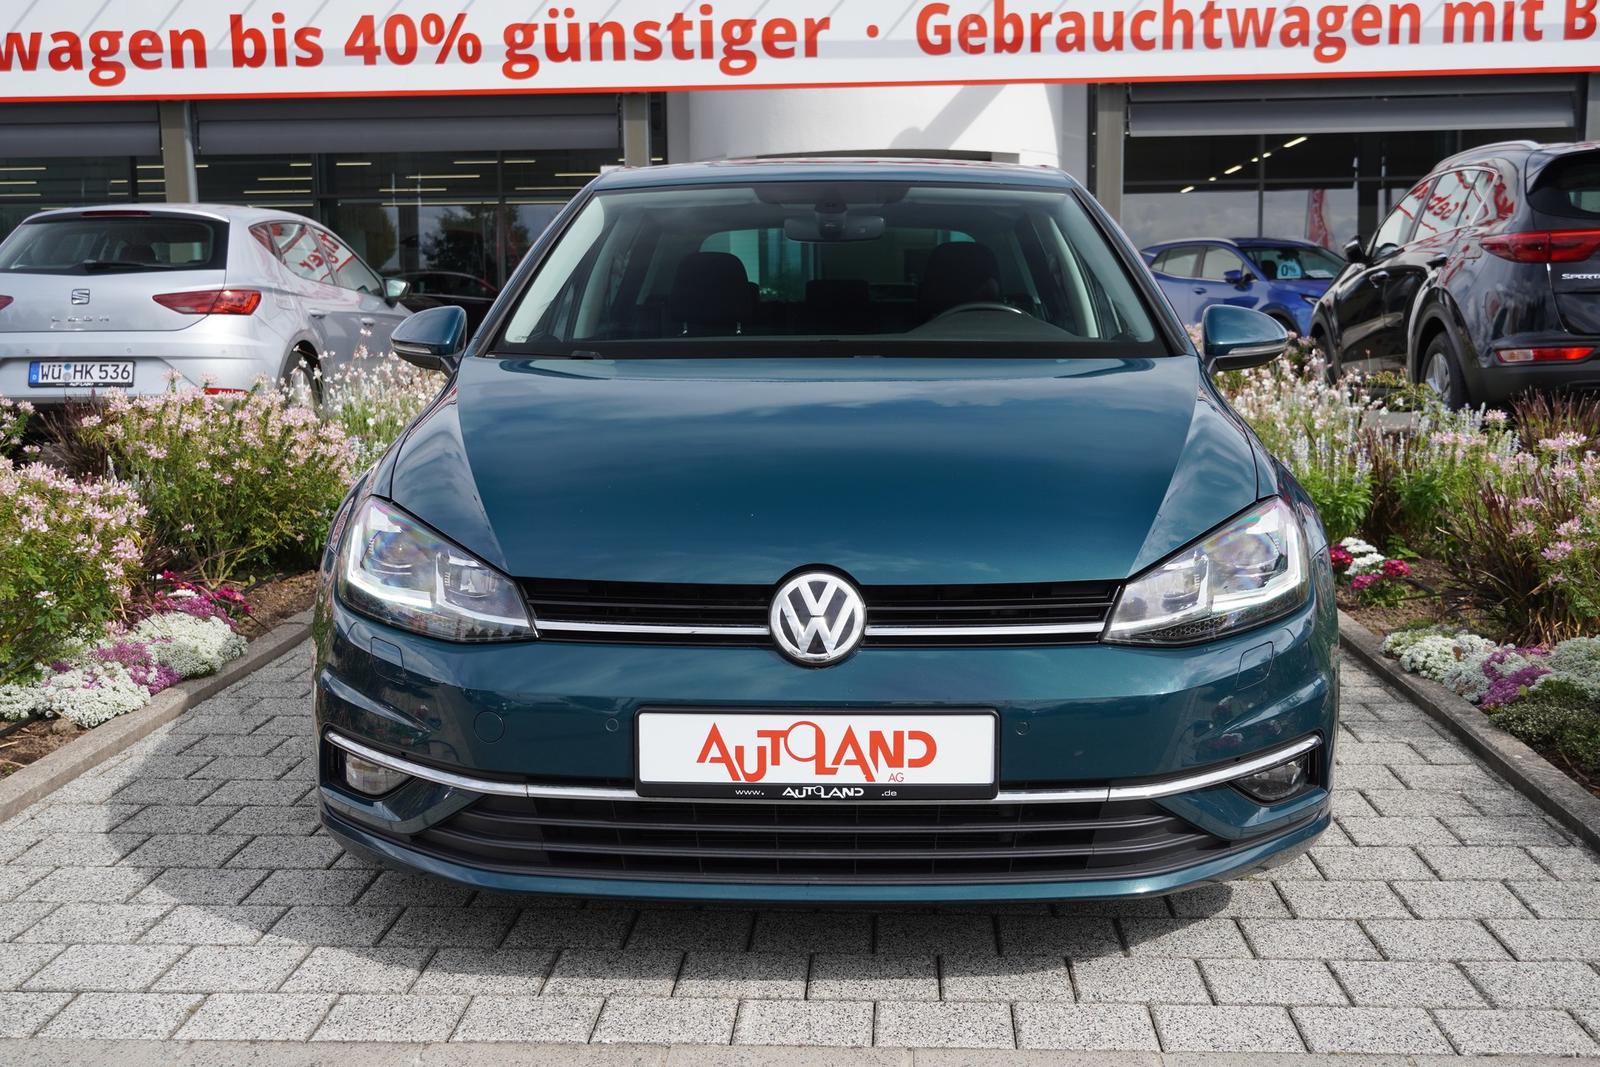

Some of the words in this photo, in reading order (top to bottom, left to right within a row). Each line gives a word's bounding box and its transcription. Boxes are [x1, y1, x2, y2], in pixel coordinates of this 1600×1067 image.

[0, 29, 207, 87] wagen
[230, 12, 323, 69] bis
[345, 13, 481, 66] 40%
[503, 3, 830, 81] günstiger
[916, 0, 1420, 63] Gebrauchtwagen
[1443, 0, 1545, 43] mit
[41, 364, 62, 380] WÜ
[73, 364, 95, 380] HK
[98, 364, 131, 380] 536
[696, 721, 938, 783] AUTOLAND
[888, 772, 906, 783] AG
[782, 786, 865, 799] AUTOLAND
